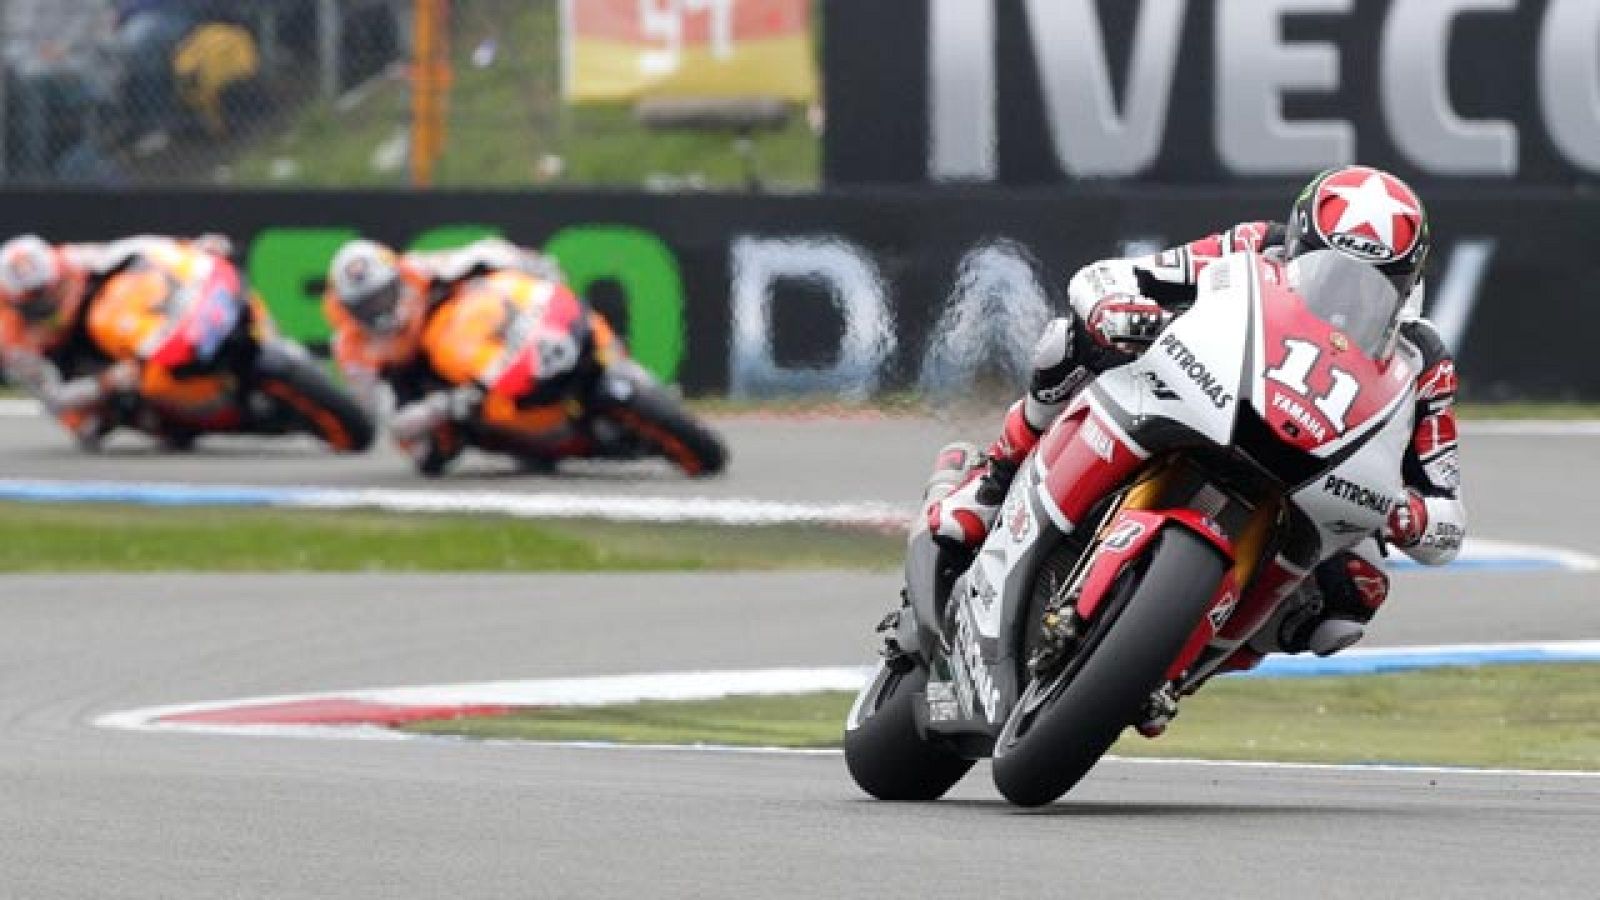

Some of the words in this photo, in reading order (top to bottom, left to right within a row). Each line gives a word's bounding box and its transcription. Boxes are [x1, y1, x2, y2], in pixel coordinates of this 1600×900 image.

[1160, 332, 1233, 408] PETRONAS
[1264, 337, 1361, 436] 11
[1272, 391, 1326, 443] YAMAHA
